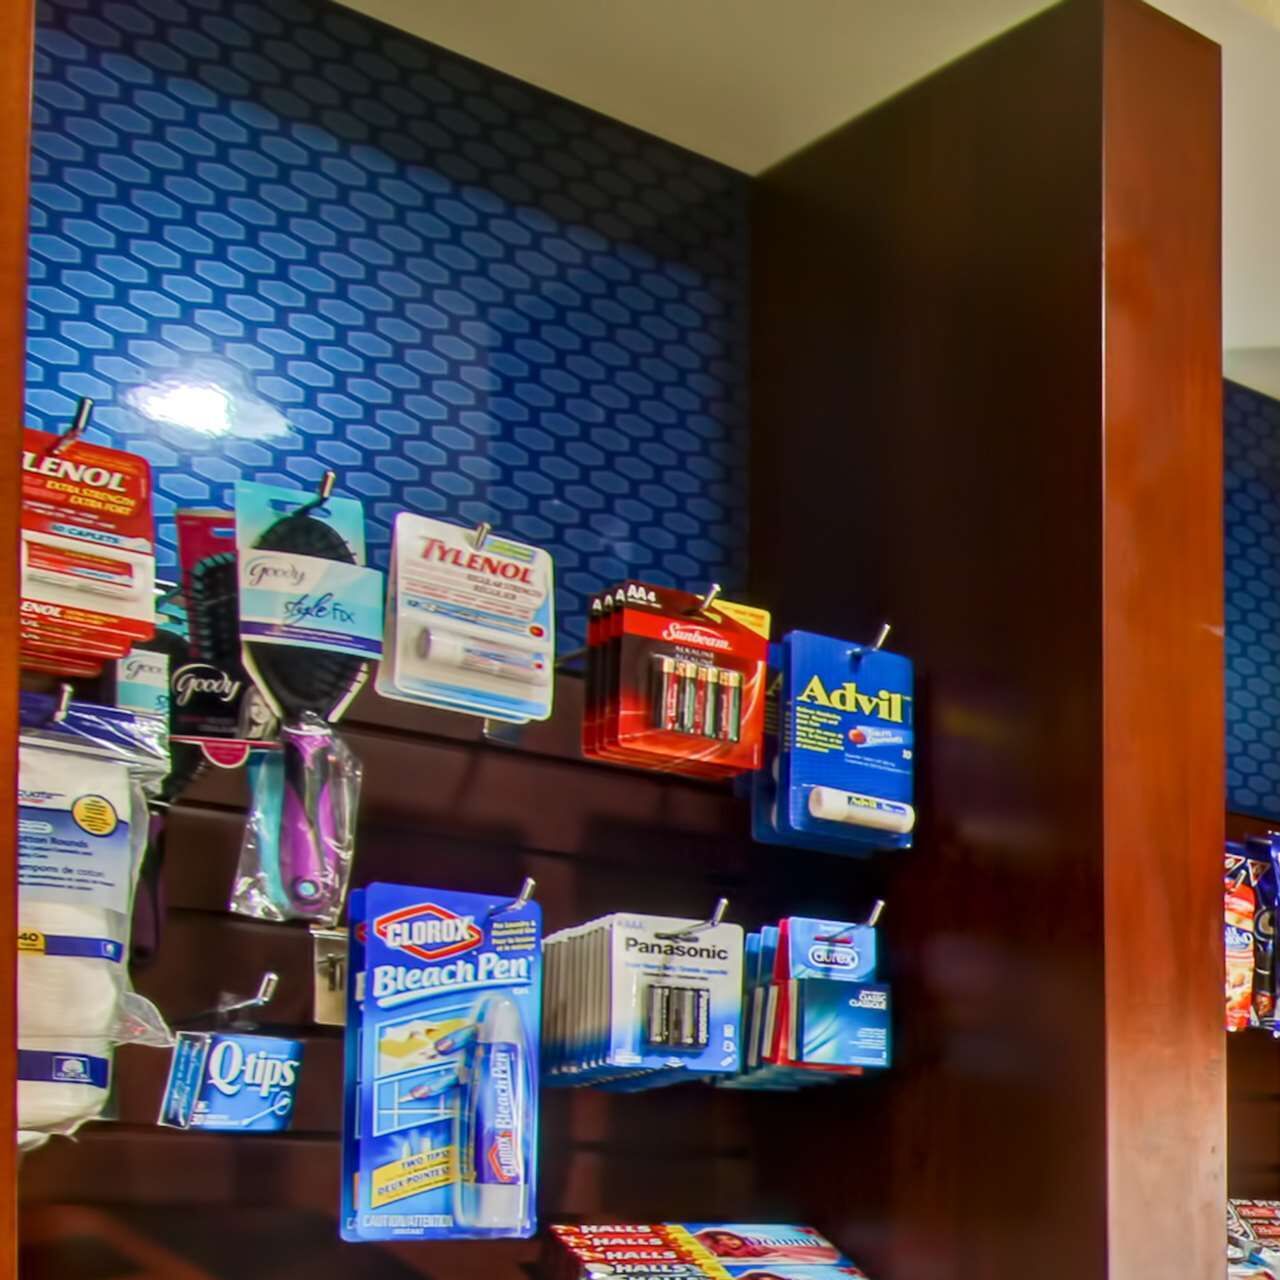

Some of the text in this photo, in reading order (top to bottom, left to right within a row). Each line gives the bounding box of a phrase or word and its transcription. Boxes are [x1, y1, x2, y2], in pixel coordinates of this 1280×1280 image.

[22, 450, 128, 492] LENOL
[418, 535, 535, 585] TYLENOL
[626, 584, 647, 600] AA
[662, 621, 733, 651] Sunbeam
[172, 663, 242, 706] goody
[796, 674, 904, 723] Advil
[385, 915, 476, 950] CLOROX
[624, 937, 729, 960] Panasonic
[372, 952, 530, 998] Bleach Pen
[208, 1040, 300, 1097] Q-tips
[580, 1224, 652, 1233] HALLS
[591, 1237, 664, 1246] HALLS
[604, 1250, 678, 1259] HALLS
[614, 1264, 688, 1273] HALLS
